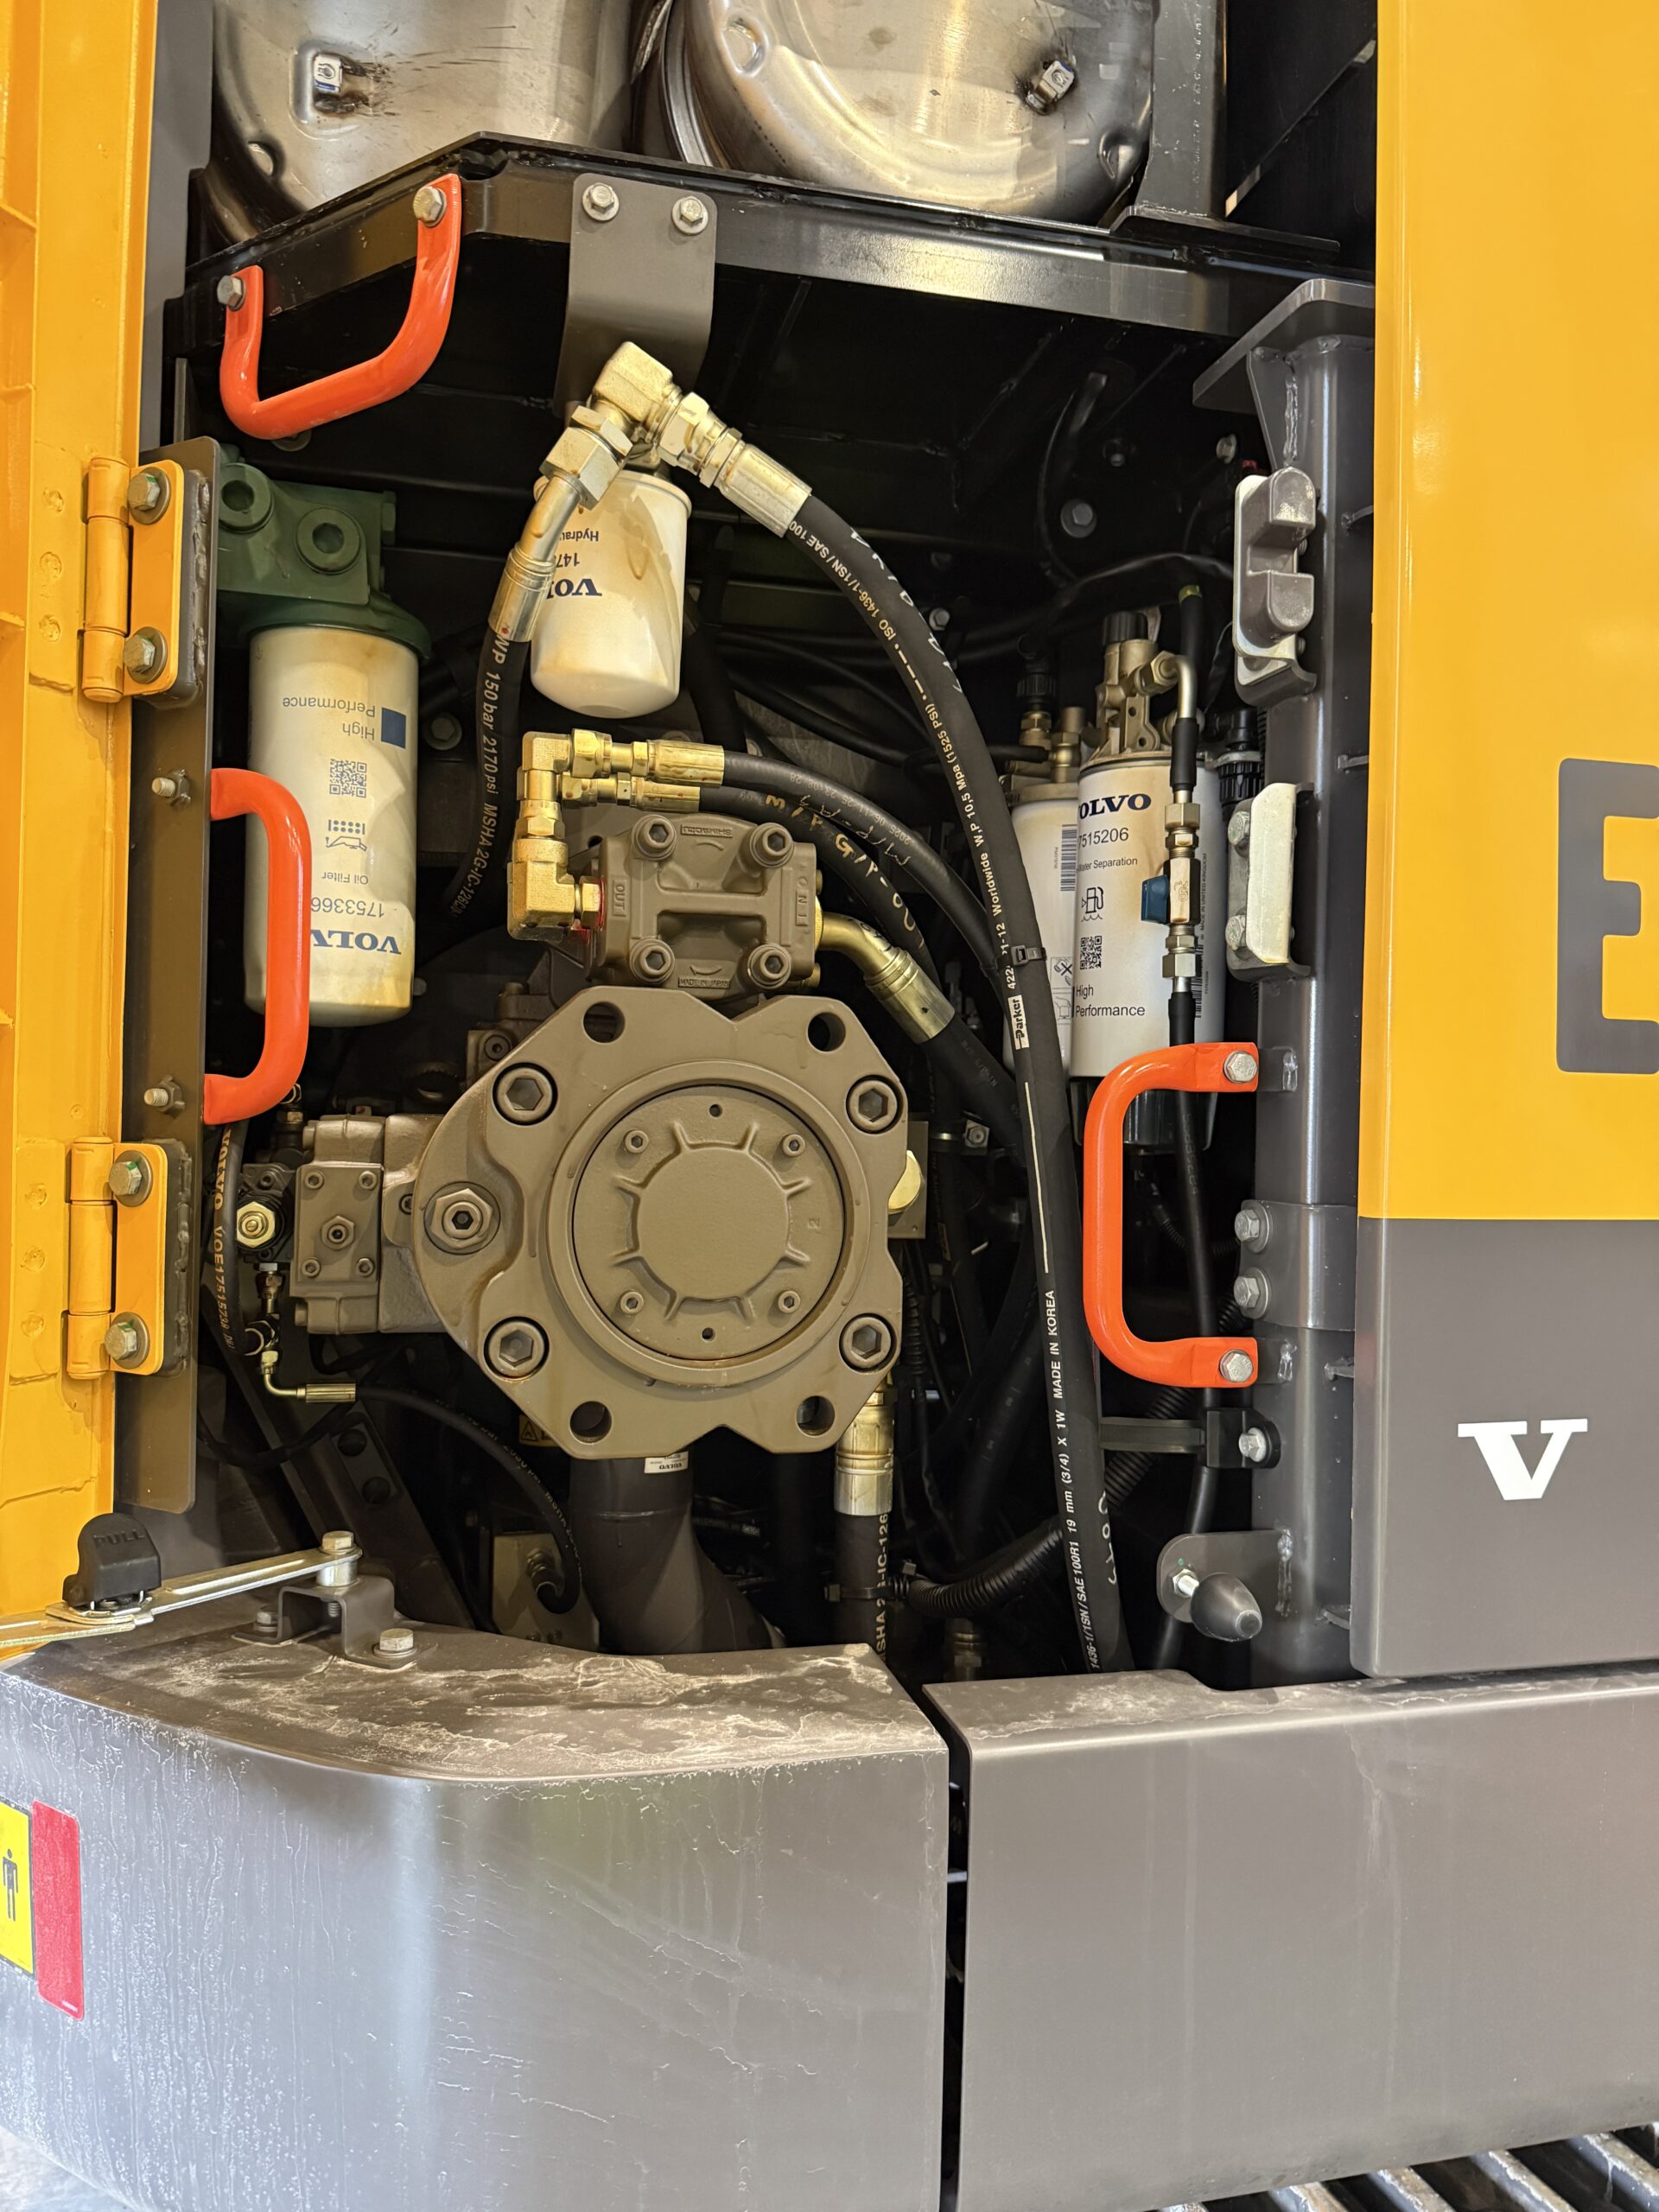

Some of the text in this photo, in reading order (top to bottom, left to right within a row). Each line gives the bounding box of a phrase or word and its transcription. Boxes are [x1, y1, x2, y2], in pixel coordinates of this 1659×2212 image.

[805, 533, 831, 559] SAE
[553, 552, 581, 569] 147
[878, 618, 897, 641] ISO
[482, 671, 502, 701] 150
[282, 696, 376, 717] Performance
[481, 702, 499, 731] bar
[925, 703, 943, 729] PSI)
[341, 722, 376, 741] High
[482, 734, 499, 773] 2170
[938, 729, 957, 765] (1525
[484, 773, 499, 795] psi
[952, 765, 968, 791] Mpa
[961, 791, 976, 819] 10,5
[1077, 792, 1152, 820] OLVO
[477, 802, 499, 847] MSHA
[1093, 856, 1138, 869] Separation
[321, 871, 369, 886] Oil Filter
[980, 852, 1003, 918] Worldwide
[614, 884, 626, 910] OUT
[1075, 983, 1094, 1000] High
[1013, 1000, 1027, 1041] Parker
[1075, 1005, 1146, 1019] Performance
[213, 1128, 232, 1211] VOLVO
[1045, 1289, 1058, 1337] KOREA
[1049, 1342, 1060, 1356] IN
[1051, 1360, 1064, 1400] MADE
[1054, 1410, 1067, 1430] 1W
[1058, 1452, 1073, 1484] (3/4)
[1458, 1418, 1588, 1501] V
[1064, 1490, 1075, 1514] mm
[93, 1529, 146, 1549] PULL
[1065, 1518, 1077, 1534] 19
[1069, 1540, 1083, 1575] 100R1
[1075, 1576, 1088, 1602] SAE
